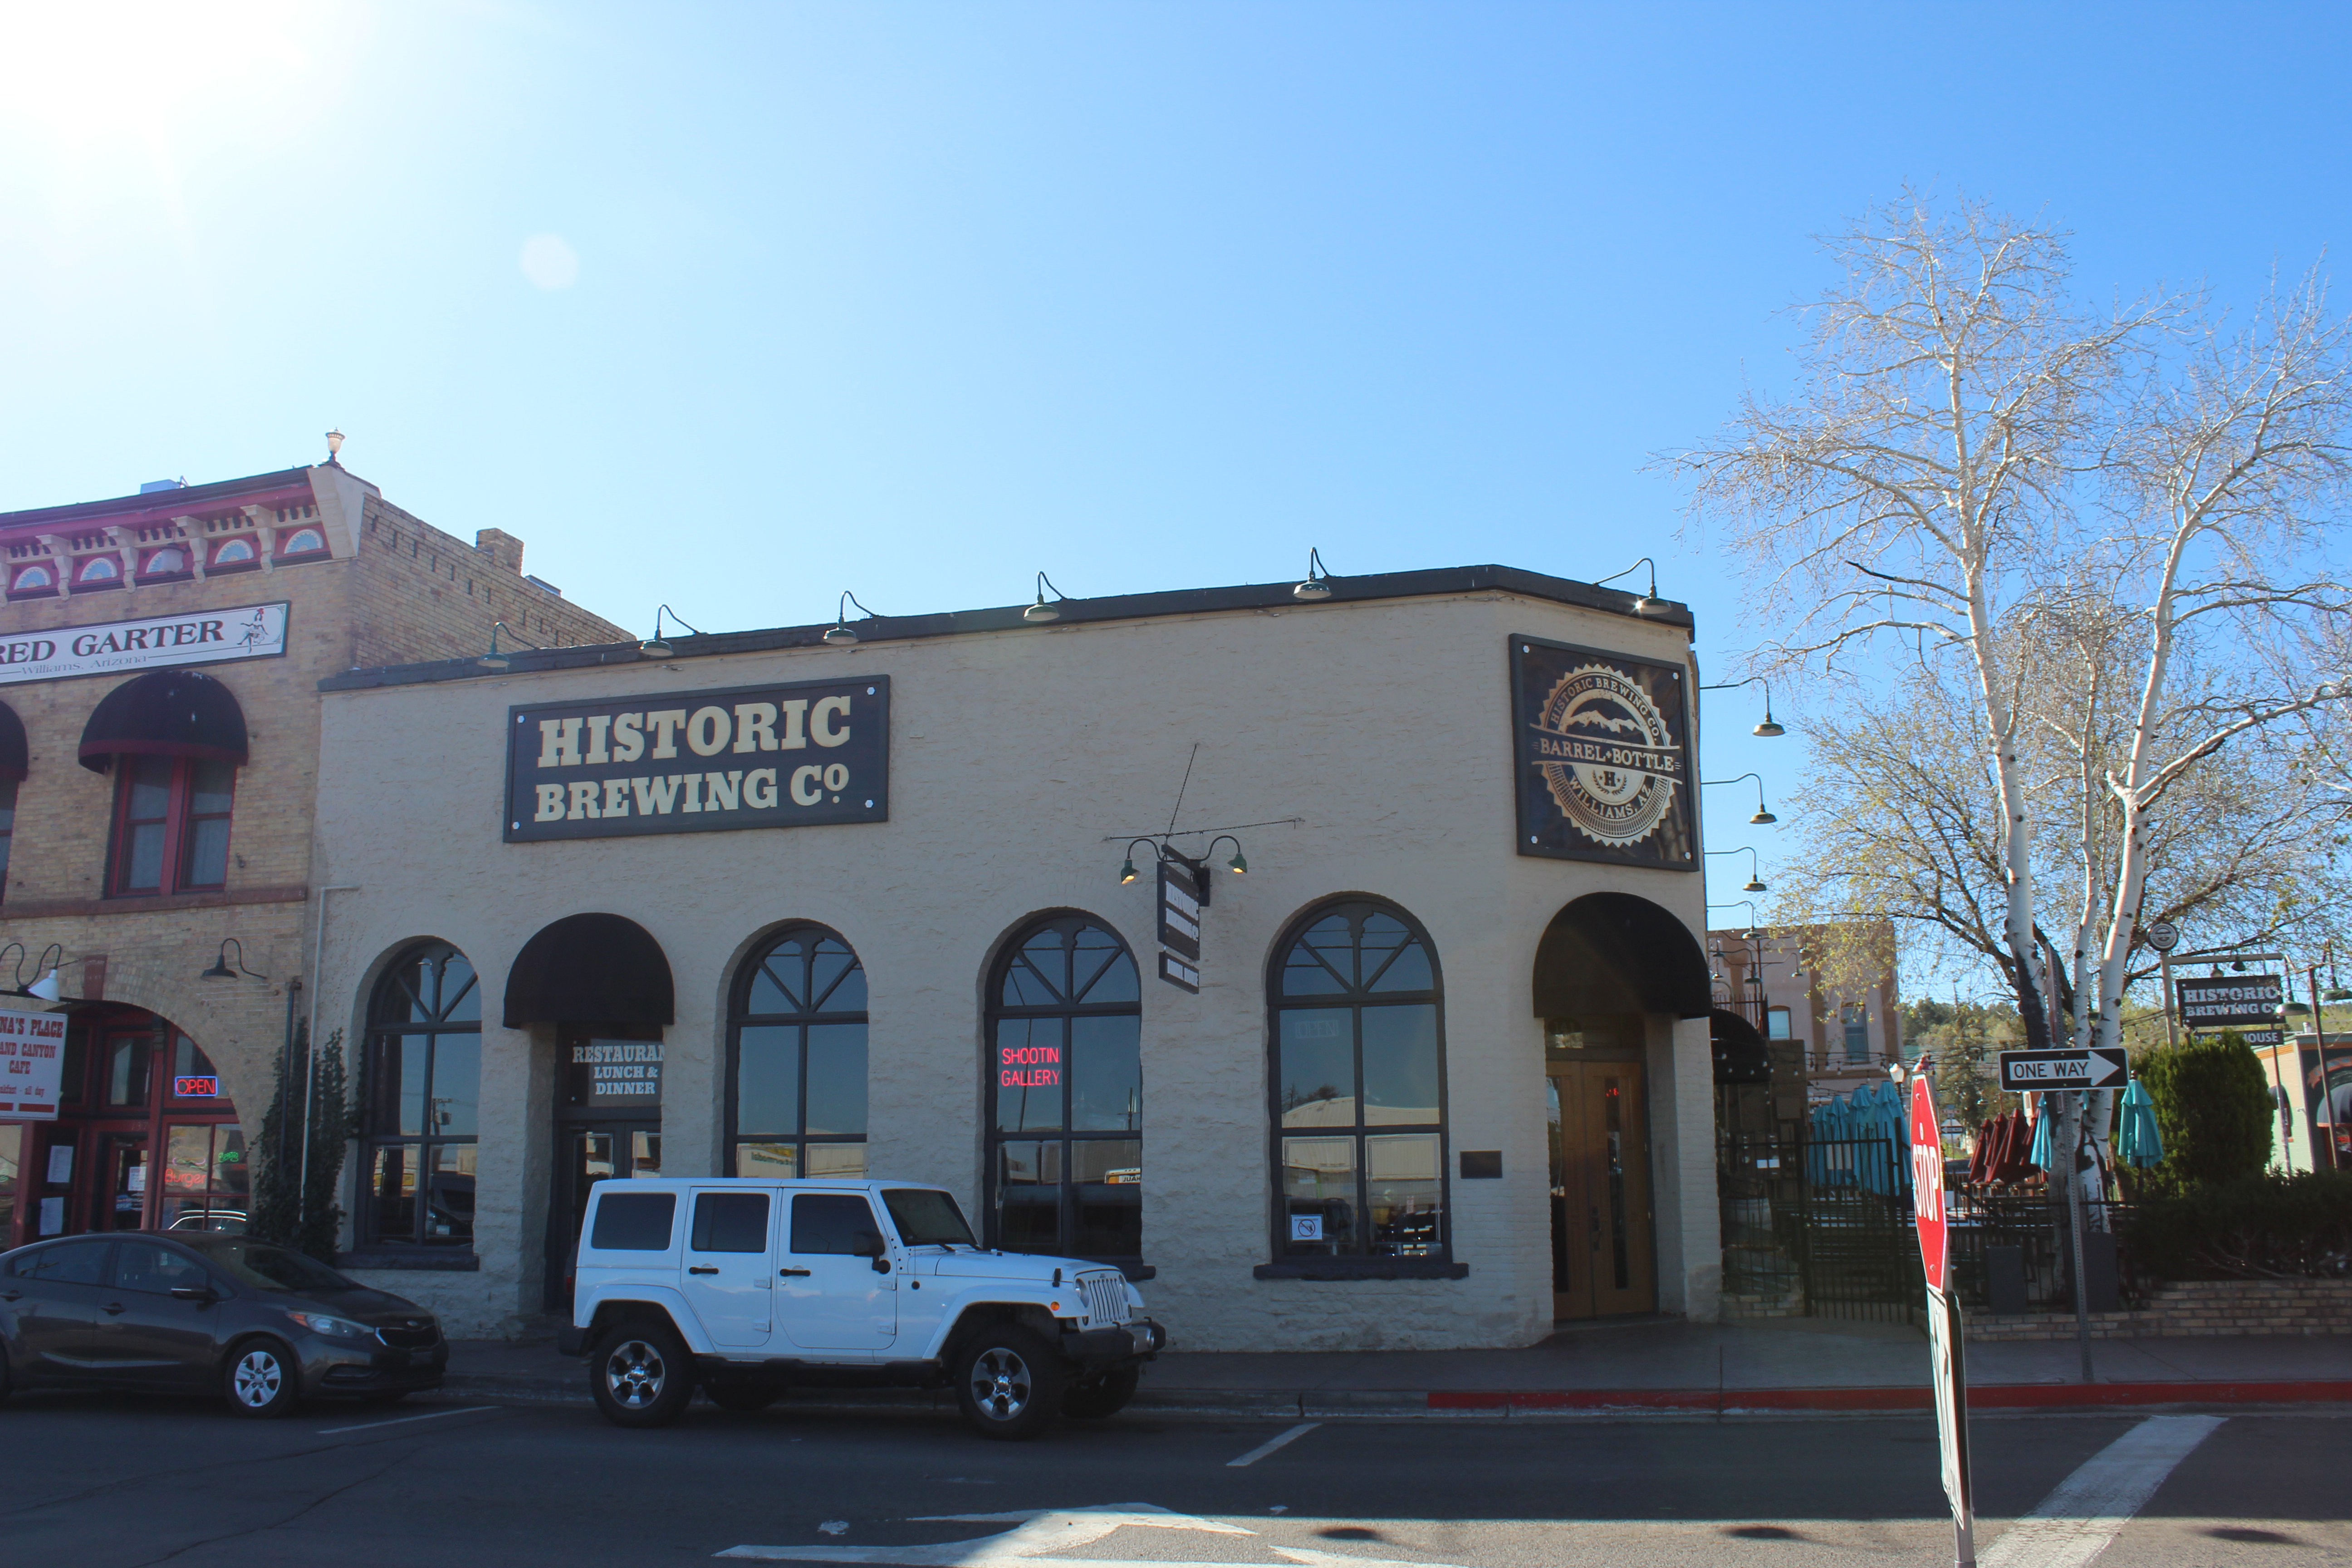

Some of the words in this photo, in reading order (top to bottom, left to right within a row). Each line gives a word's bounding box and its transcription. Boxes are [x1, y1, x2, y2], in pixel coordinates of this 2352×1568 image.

[72, 620, 225, 657] GARTER
[90, 655, 147, 668] Arizona
[1551, 677, 1593, 725] HISTORIC
[1595, 677, 1648, 716] BREWING
[537, 695, 851, 768] HISTORIC
[534, 768, 779, 822] BREWING
[1637, 784, 1651, 807] AZ
[2183, 986, 2278, 1003] HISTORIC
[2185, 1003, 2259, 1017] BREWING
[30, 1019, 64, 1038] PLACE
[1298, 1021, 1336, 1038] OPEN
[22, 1043, 56, 1058] CANYON
[1001, 1047, 1060, 1064] SHOOTIN
[9, 1060, 31, 1074] CAFE
[594, 1066, 644, 1079] LUNCH
[647, 1066, 658, 1078] &
[2014, 1063, 2047, 1078] ONE
[2053, 1061, 2088, 1077] WAY
[176, 1078, 216, 1094] OPEN
[1001, 1069, 1061, 1087] GALLERY
[595, 1082, 656, 1095] DINNER
[165, 1168, 206, 1188] Burger
[1912, 1143, 1939, 1222] STOP
